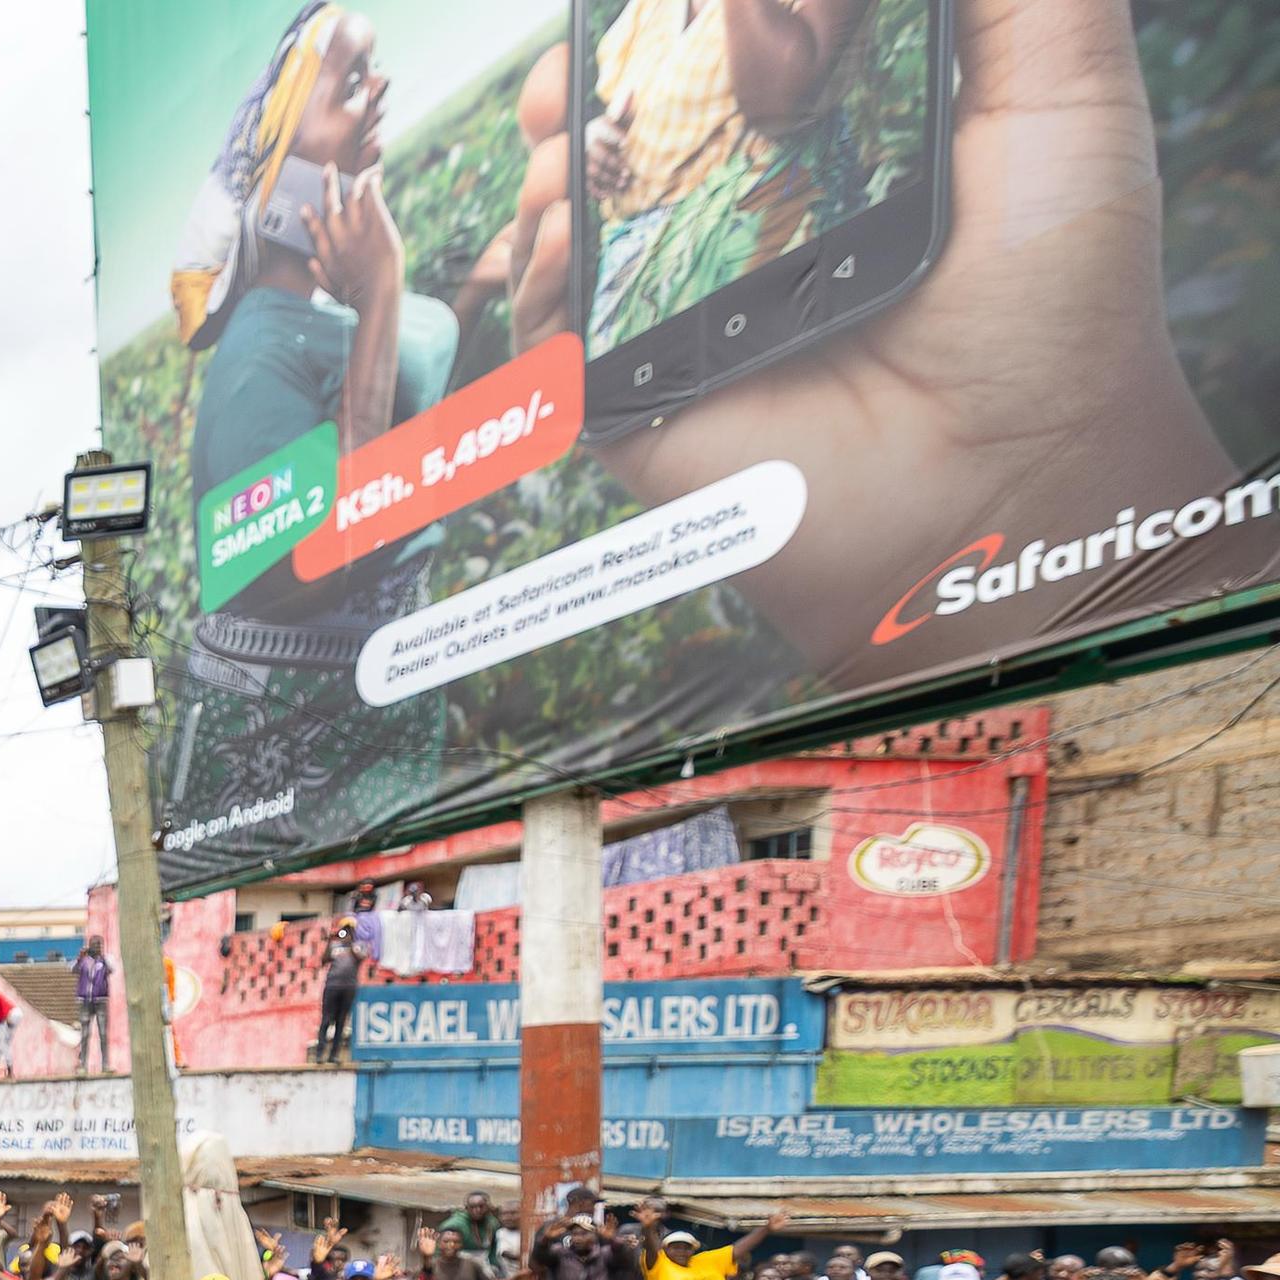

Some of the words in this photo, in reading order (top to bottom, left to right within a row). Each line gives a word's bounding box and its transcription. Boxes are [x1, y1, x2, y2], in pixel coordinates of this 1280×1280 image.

[421, 389, 555, 487] 5,499/-
[211, 497, 306, 568] SMARTA
[306, 485, 326, 519] 2
[213, 468, 292, 534] NEON
[386, 650, 438, 683] Dealer
[445, 624, 507, 660] Outlets
[513, 604, 551, 633] and
[556, 526, 757, 616] www.masoko.com
[392, 615, 467, 657] Available
[472, 603, 492, 624] at
[497, 563, 595, 615] Safaricom
[601, 529, 664, 571] Retail
[206, 815, 228, 838] on
[227, 787, 295, 829] Android
[356, 999, 478, 1043] ISRAEL
[35, 1118, 64, 1133] AND
[42, 1136, 72, 1150] AND
[80, 1135, 128, 1151] RETAIL
[397, 1117, 473, 1144] ISRAEL
[715, 1113, 851, 1138] ISRAEL
[872, 1109, 1152, 1134] WHOLESALERS
